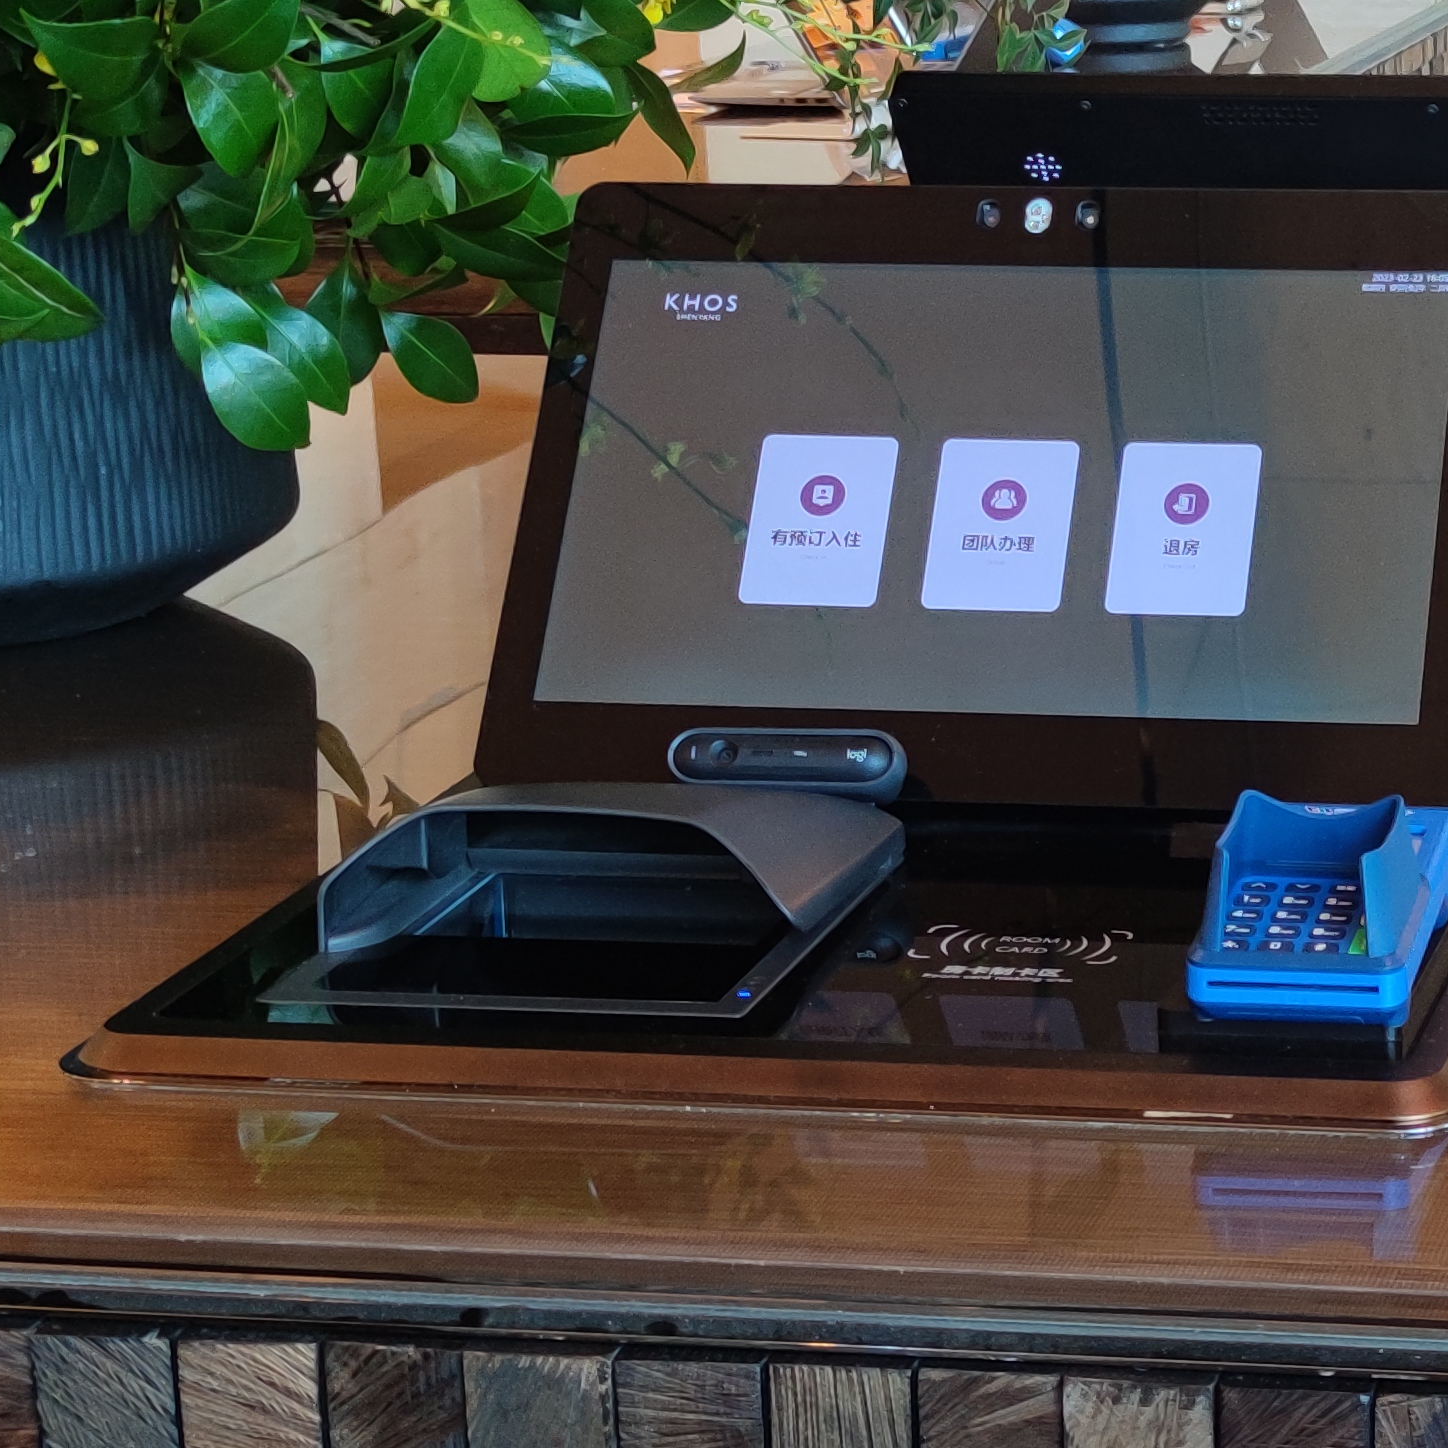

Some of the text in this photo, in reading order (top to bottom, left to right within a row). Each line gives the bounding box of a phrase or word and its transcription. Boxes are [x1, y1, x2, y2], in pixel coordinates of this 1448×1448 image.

[664, 292, 738, 313] KHOS
[770, 528, 862, 548] 有预订入住
[961, 533, 1036, 552] 团队办理
[1162, 537, 1201, 556] 退房
[846, 748, 868, 763] logi
[999, 935, 1062, 944] ROOM
[994, 946, 1049, 954] CARD
